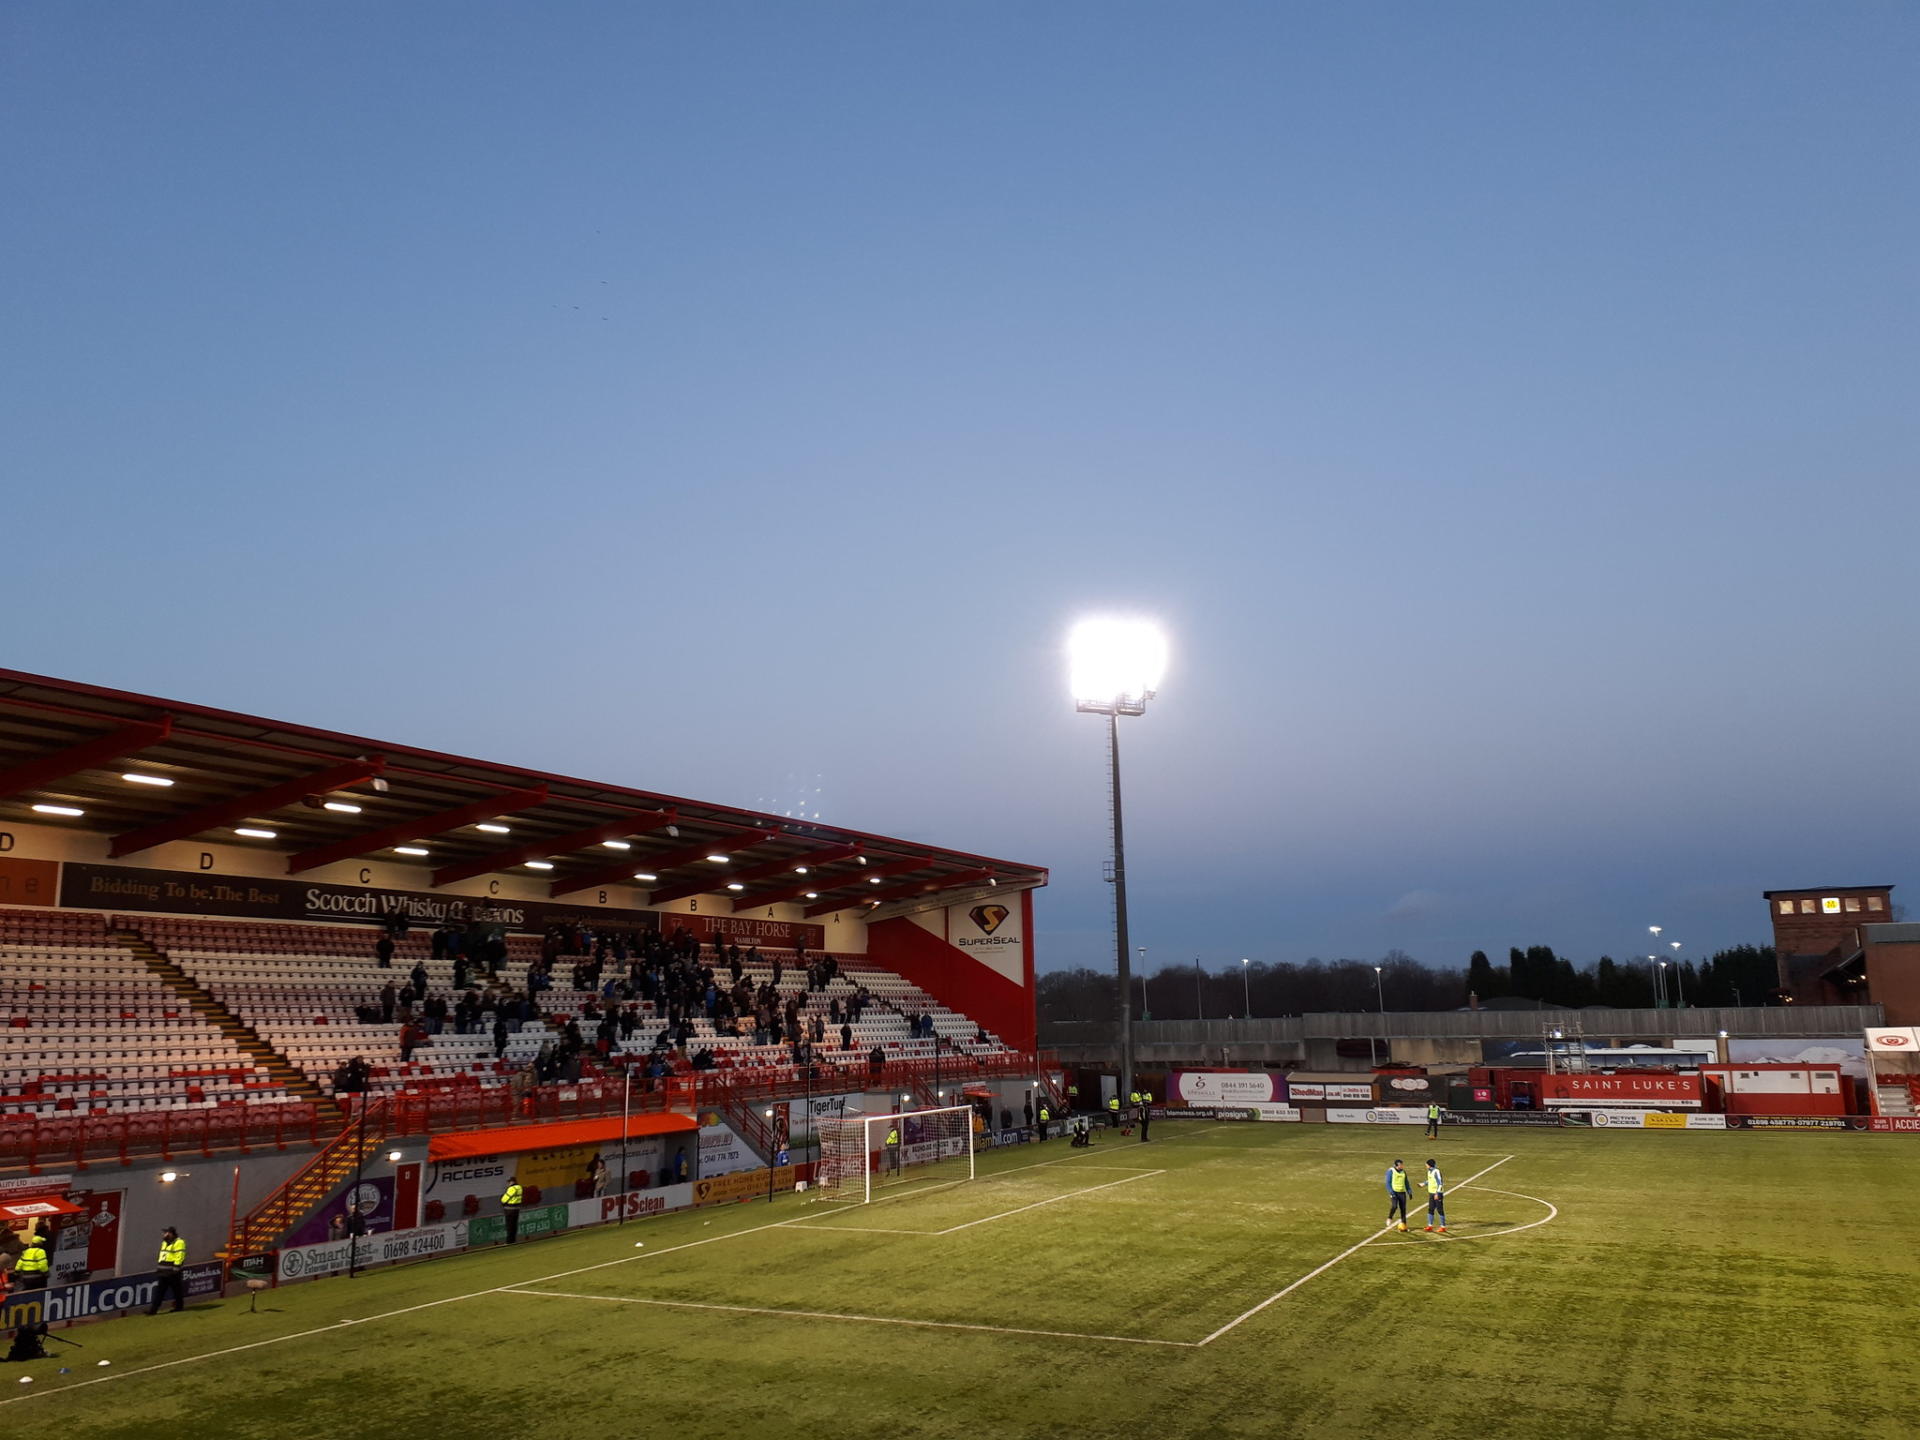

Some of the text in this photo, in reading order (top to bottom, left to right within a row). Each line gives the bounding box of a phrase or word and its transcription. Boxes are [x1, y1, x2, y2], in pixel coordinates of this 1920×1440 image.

[201, 852, 213, 870] D
[360, 868, 371, 884] C
[90, 876, 160, 902] Bidding
[164, 881, 186, 897] To
[213, 886, 243, 902] The
[248, 889, 280, 904] Best
[489, 880, 500, 895] C
[599, 890, 608, 904] B
[305, 888, 377, 914] Scotch
[380, 895, 447, 924] Whisky
[449, 900, 525, 924] Acons
[690, 899, 698, 912] B
[767, 906, 775, 918] A
[834, 913, 842, 923] A
[703, 917, 791, 938] THE BAY HORSE
[735, 936, 762, 945] HAMILTON
[1572, 1080, 1692, 1091] SAINT LUKE'S
[1218, 1109, 1248, 1120] prosigns
[441, 1165, 504, 1183] ACCESS
[384, 1234, 445, 1259] 01698 424400
[56, 1263, 71, 1272] BIG
